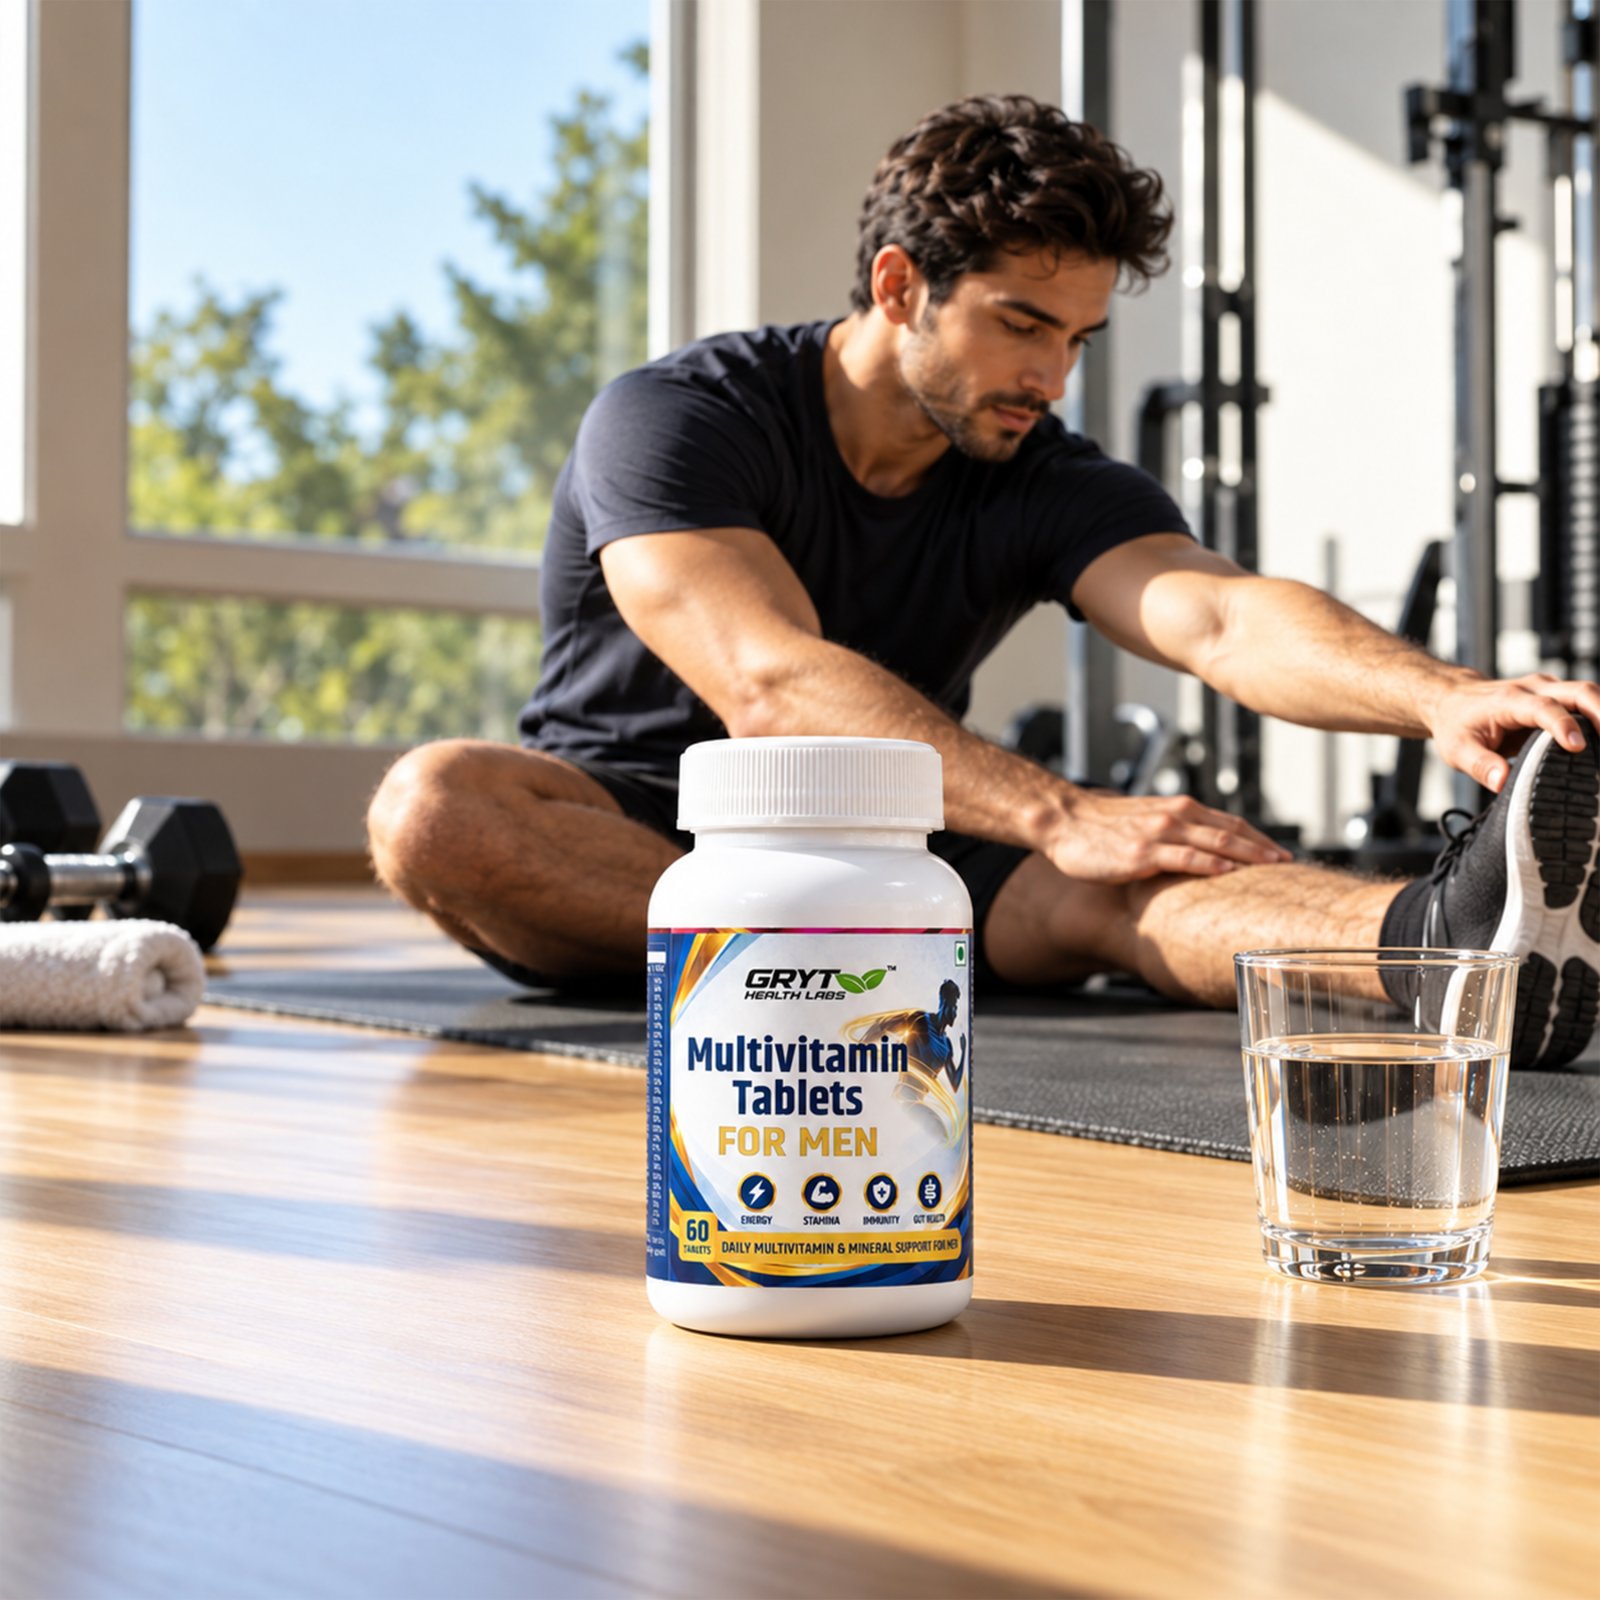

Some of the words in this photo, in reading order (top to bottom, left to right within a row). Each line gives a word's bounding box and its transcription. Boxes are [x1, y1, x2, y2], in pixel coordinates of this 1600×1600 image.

[745, 968, 842, 989] GRYT
[744, 990, 802, 1001] HEALTH
[805, 990, 847, 1001] LABS
[687, 1035, 909, 1073] Multivitamin
[732, 1079, 863, 1116] Tablets
[718, 1126, 786, 1157] FOR
[800, 1127, 878, 1158] MEN
[686, 1218, 710, 1243] 60
[721, 1241, 752, 1254] DAILY
[754, 1242, 835, 1255] MULTIVITAMIN
[837, 1242, 846, 1255] &
[848, 1241, 894, 1255] MINERAL
[895, 1240, 932, 1254] SUPPORT
